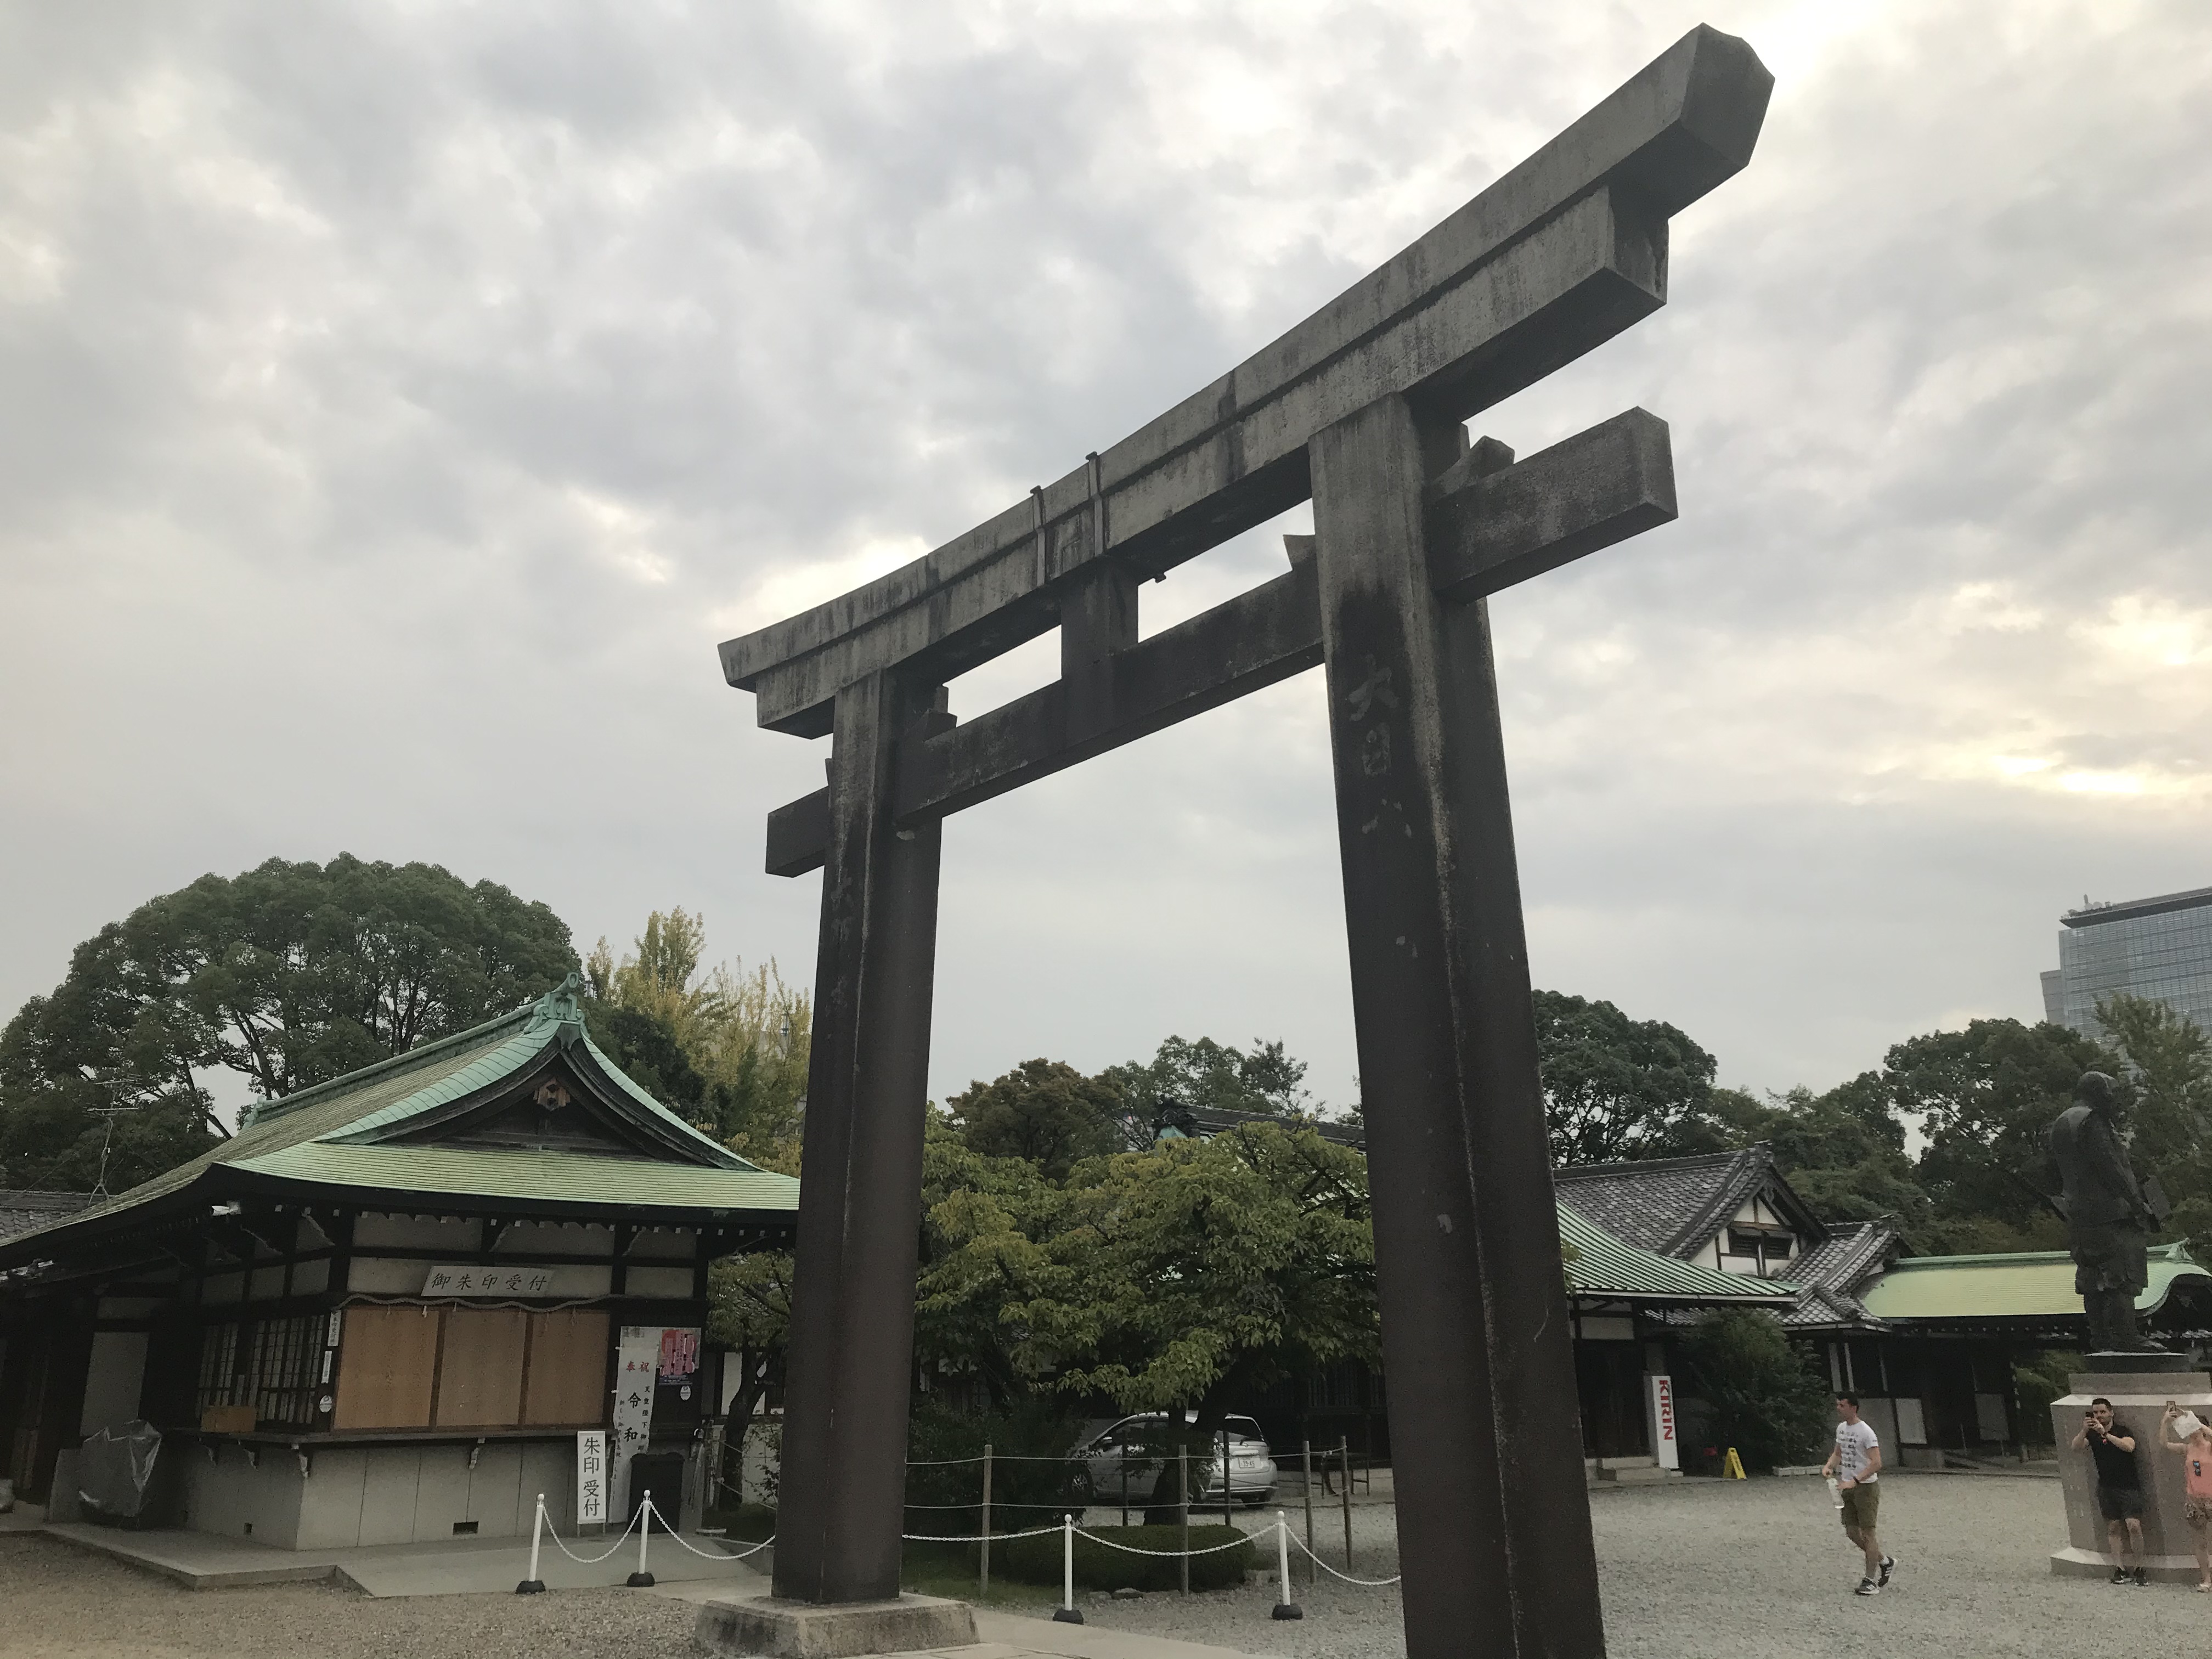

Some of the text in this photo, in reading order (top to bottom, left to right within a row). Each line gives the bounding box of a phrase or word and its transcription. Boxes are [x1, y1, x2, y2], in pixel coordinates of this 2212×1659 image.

[431, 1273, 547, 1291] 御朱印受付
[625, 1361, 650, 1372] 奉祝
[624, 1392, 641, 1442] 令和
[1659, 1380, 1673, 1440] KIRIN
[583, 1437, 600, 1517] 朱印受付
